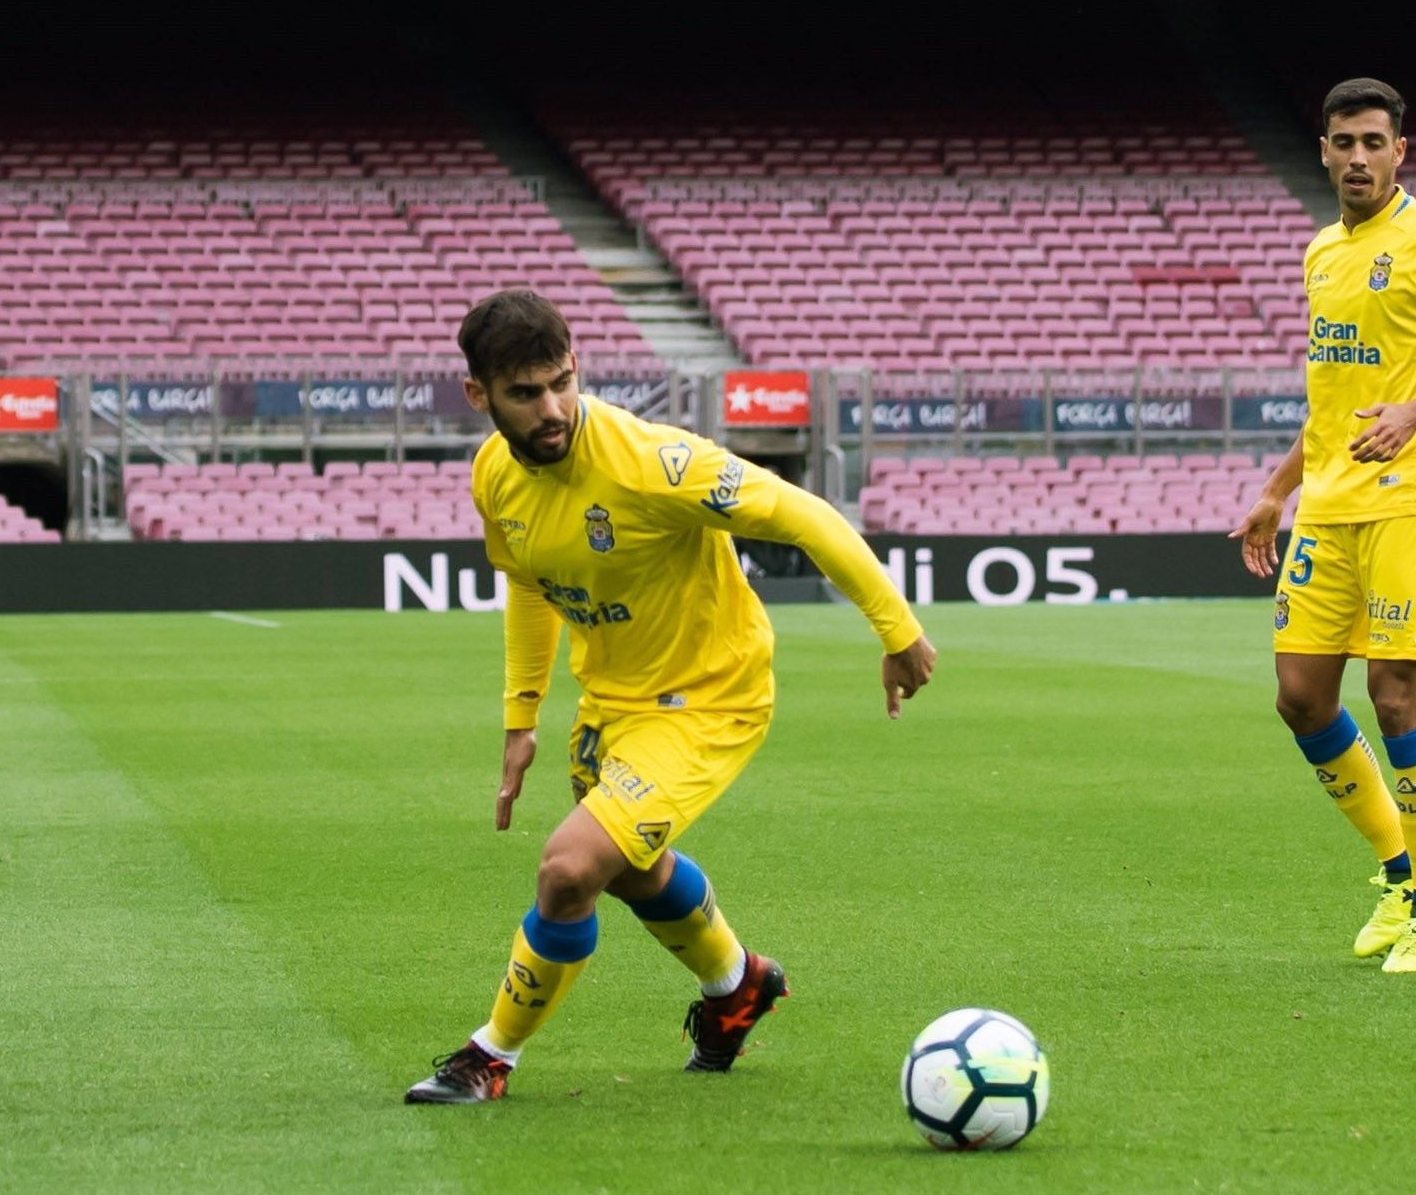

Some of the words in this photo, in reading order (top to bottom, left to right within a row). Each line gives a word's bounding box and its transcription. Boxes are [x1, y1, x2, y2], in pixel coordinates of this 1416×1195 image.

[1314, 316, 1358, 341] Gran
[1307, 338, 1381, 365] Canaria
[383, 553, 507, 613] Nu
